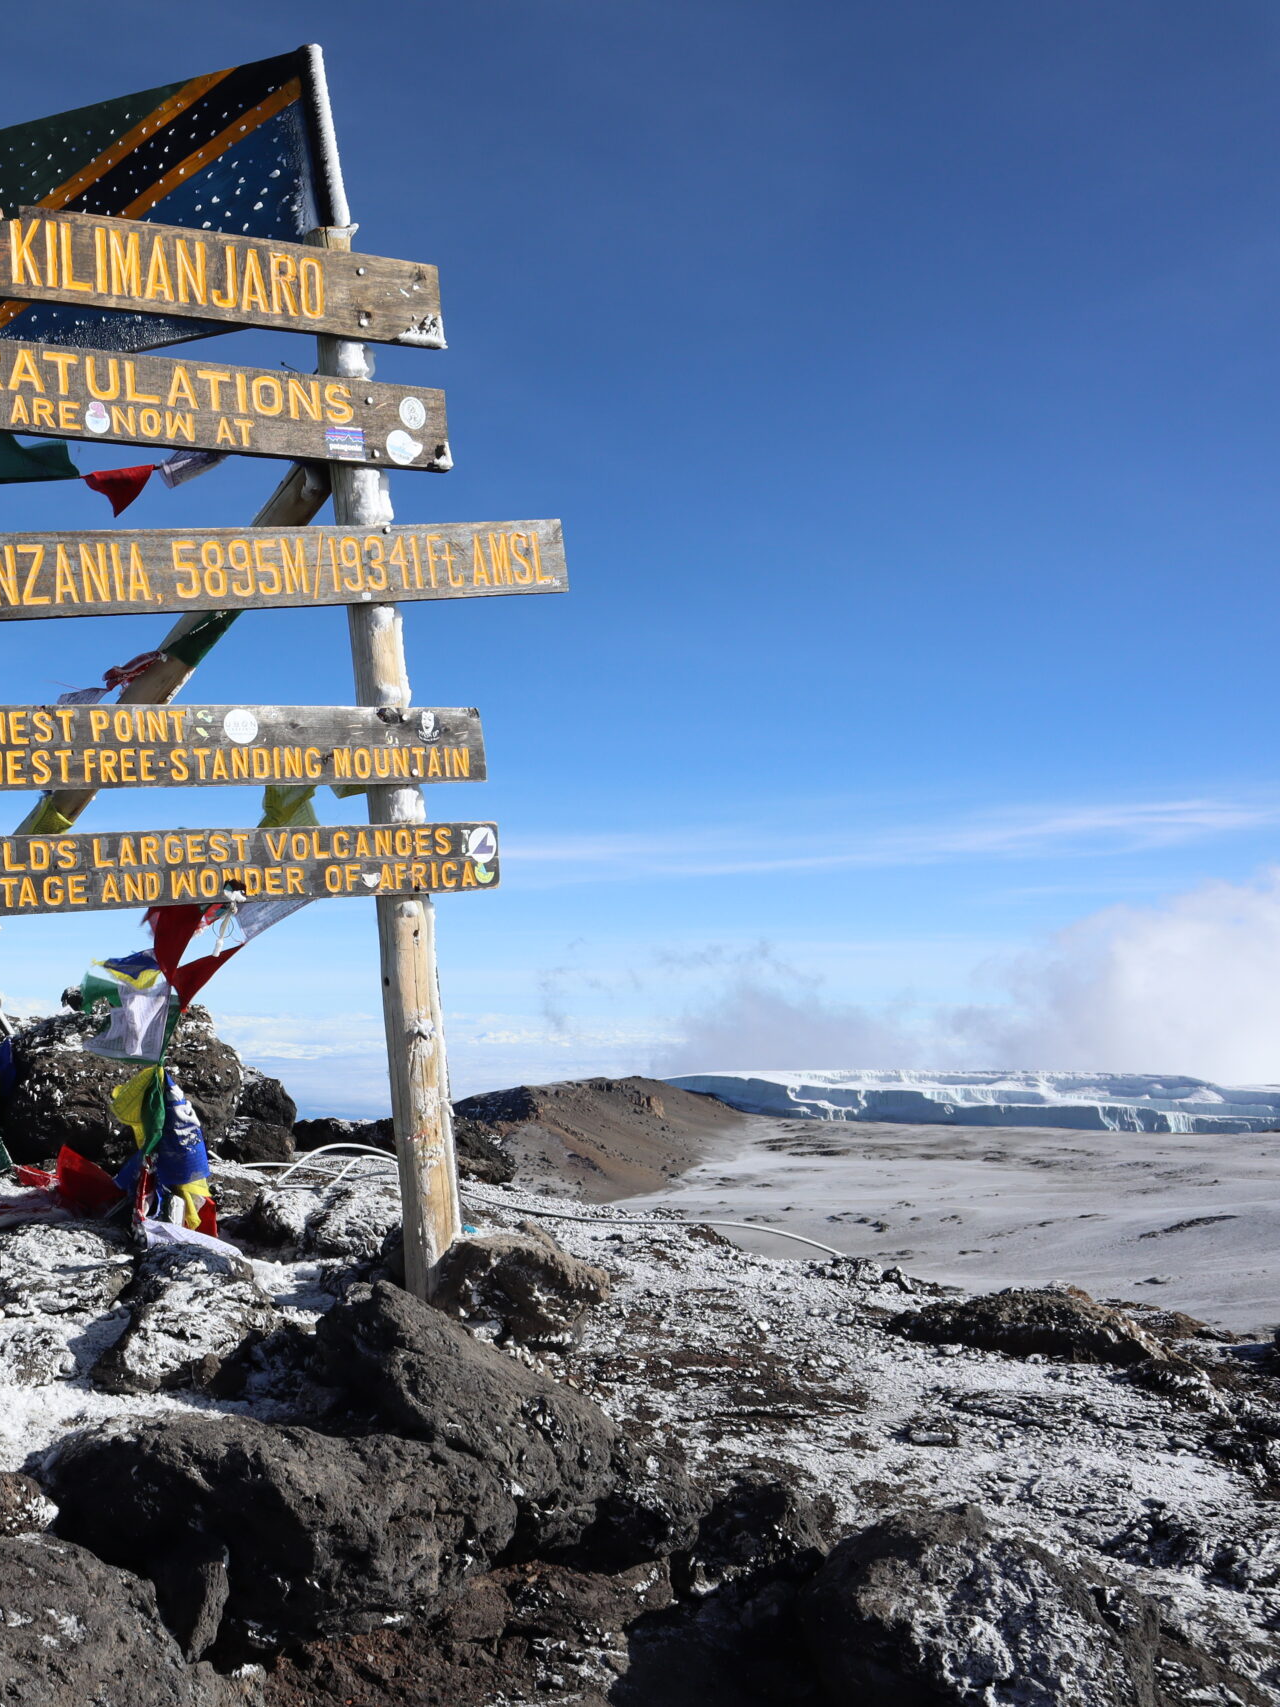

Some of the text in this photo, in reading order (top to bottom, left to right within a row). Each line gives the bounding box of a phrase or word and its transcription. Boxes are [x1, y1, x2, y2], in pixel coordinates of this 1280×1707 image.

[10, 218, 326, 319] KILIMANJARO
[11, 396, 81, 430] ARE
[111, 404, 195, 442] NOW
[216, 418, 254, 444] AT
[91, 710, 185, 741] POINT
[333, 747, 470, 778] MOUNTAIN
[93, 835, 249, 867] LARGEST
[266, 828, 452, 860] VOLCANOES
[102, 873, 160, 902] AND
[325, 864, 360, 891] OF
[379, 861, 477, 888] AFRICA
